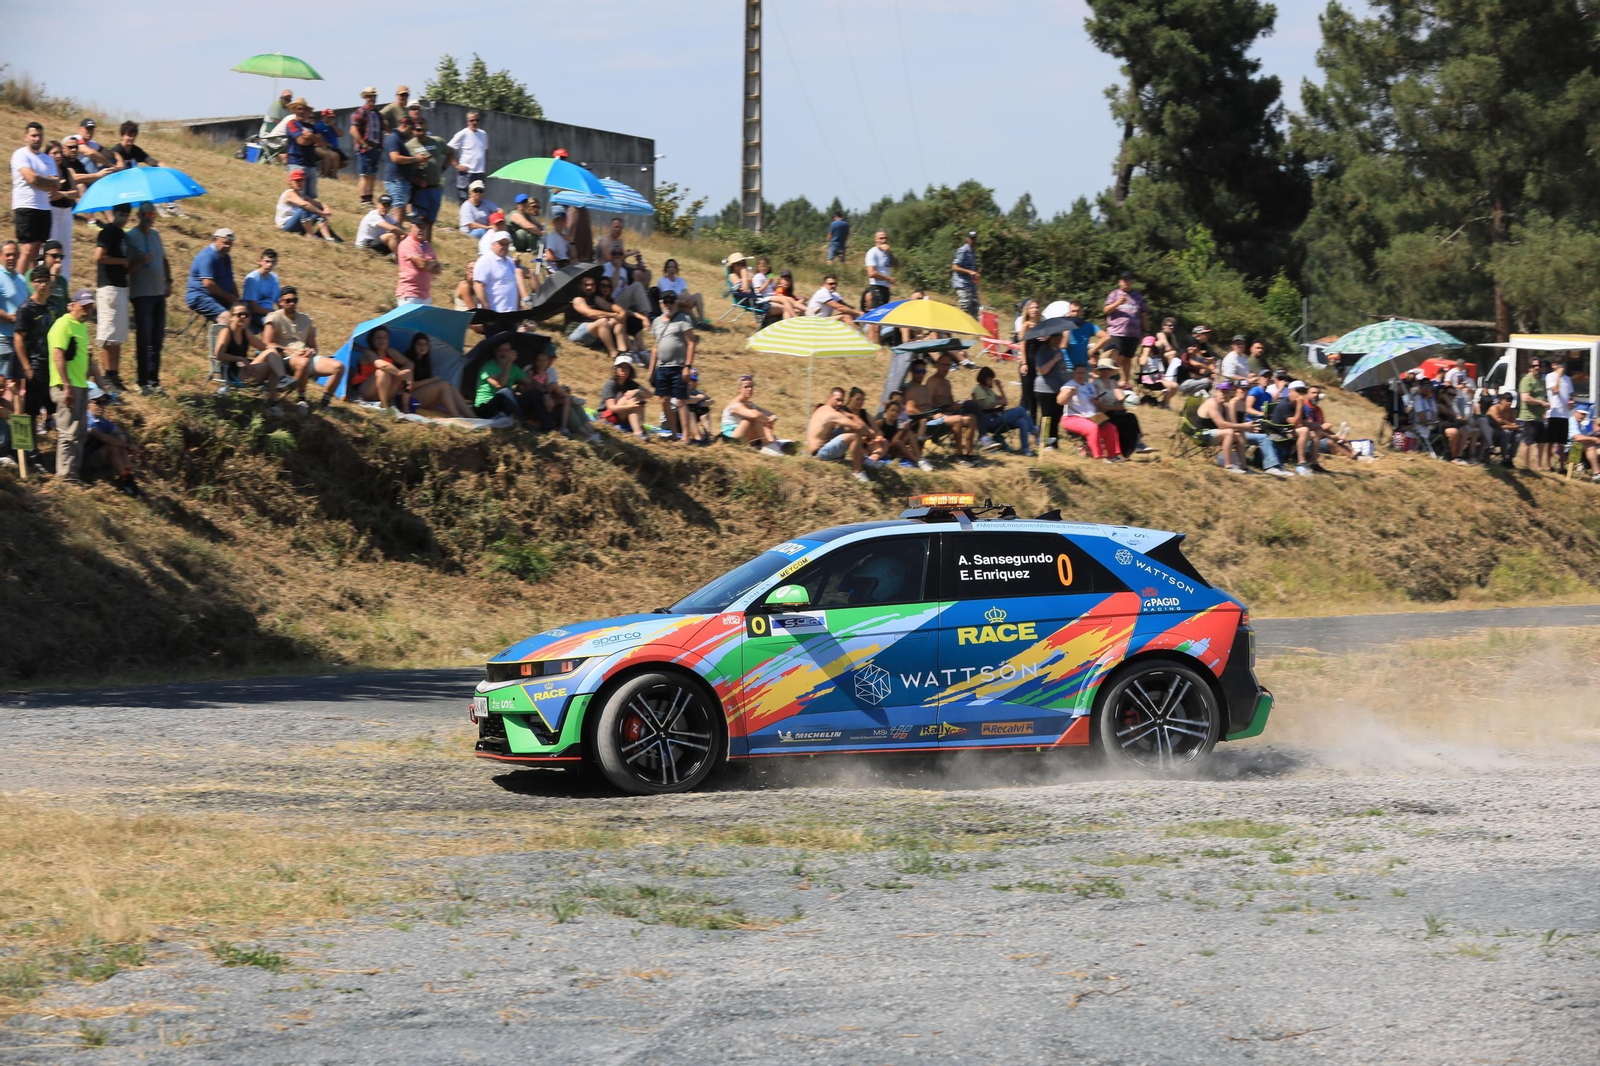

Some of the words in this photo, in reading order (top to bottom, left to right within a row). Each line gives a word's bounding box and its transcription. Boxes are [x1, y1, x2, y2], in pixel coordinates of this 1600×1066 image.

[779, 557, 809, 578] MEYCOM
[958, 554, 972, 566] A.
[973, 552, 1054, 567] Sansegundo
[1057, 553, 1073, 587] 0
[960, 569, 973, 581] E.
[974, 568, 1030, 582] Enriquez
[1135, 559, 1195, 595] WATTSON
[1150, 597, 1180, 607] PAGID
[751, 616, 766, 635] 0
[957, 621, 1039, 646] RACE
[592, 631, 642, 648] sparco
[899, 661, 1038, 689] WATTSON
[533, 687, 568, 702] RACE
[794, 731, 842, 739] MICHELIN
[990, 723, 1025, 734] Recalvi
